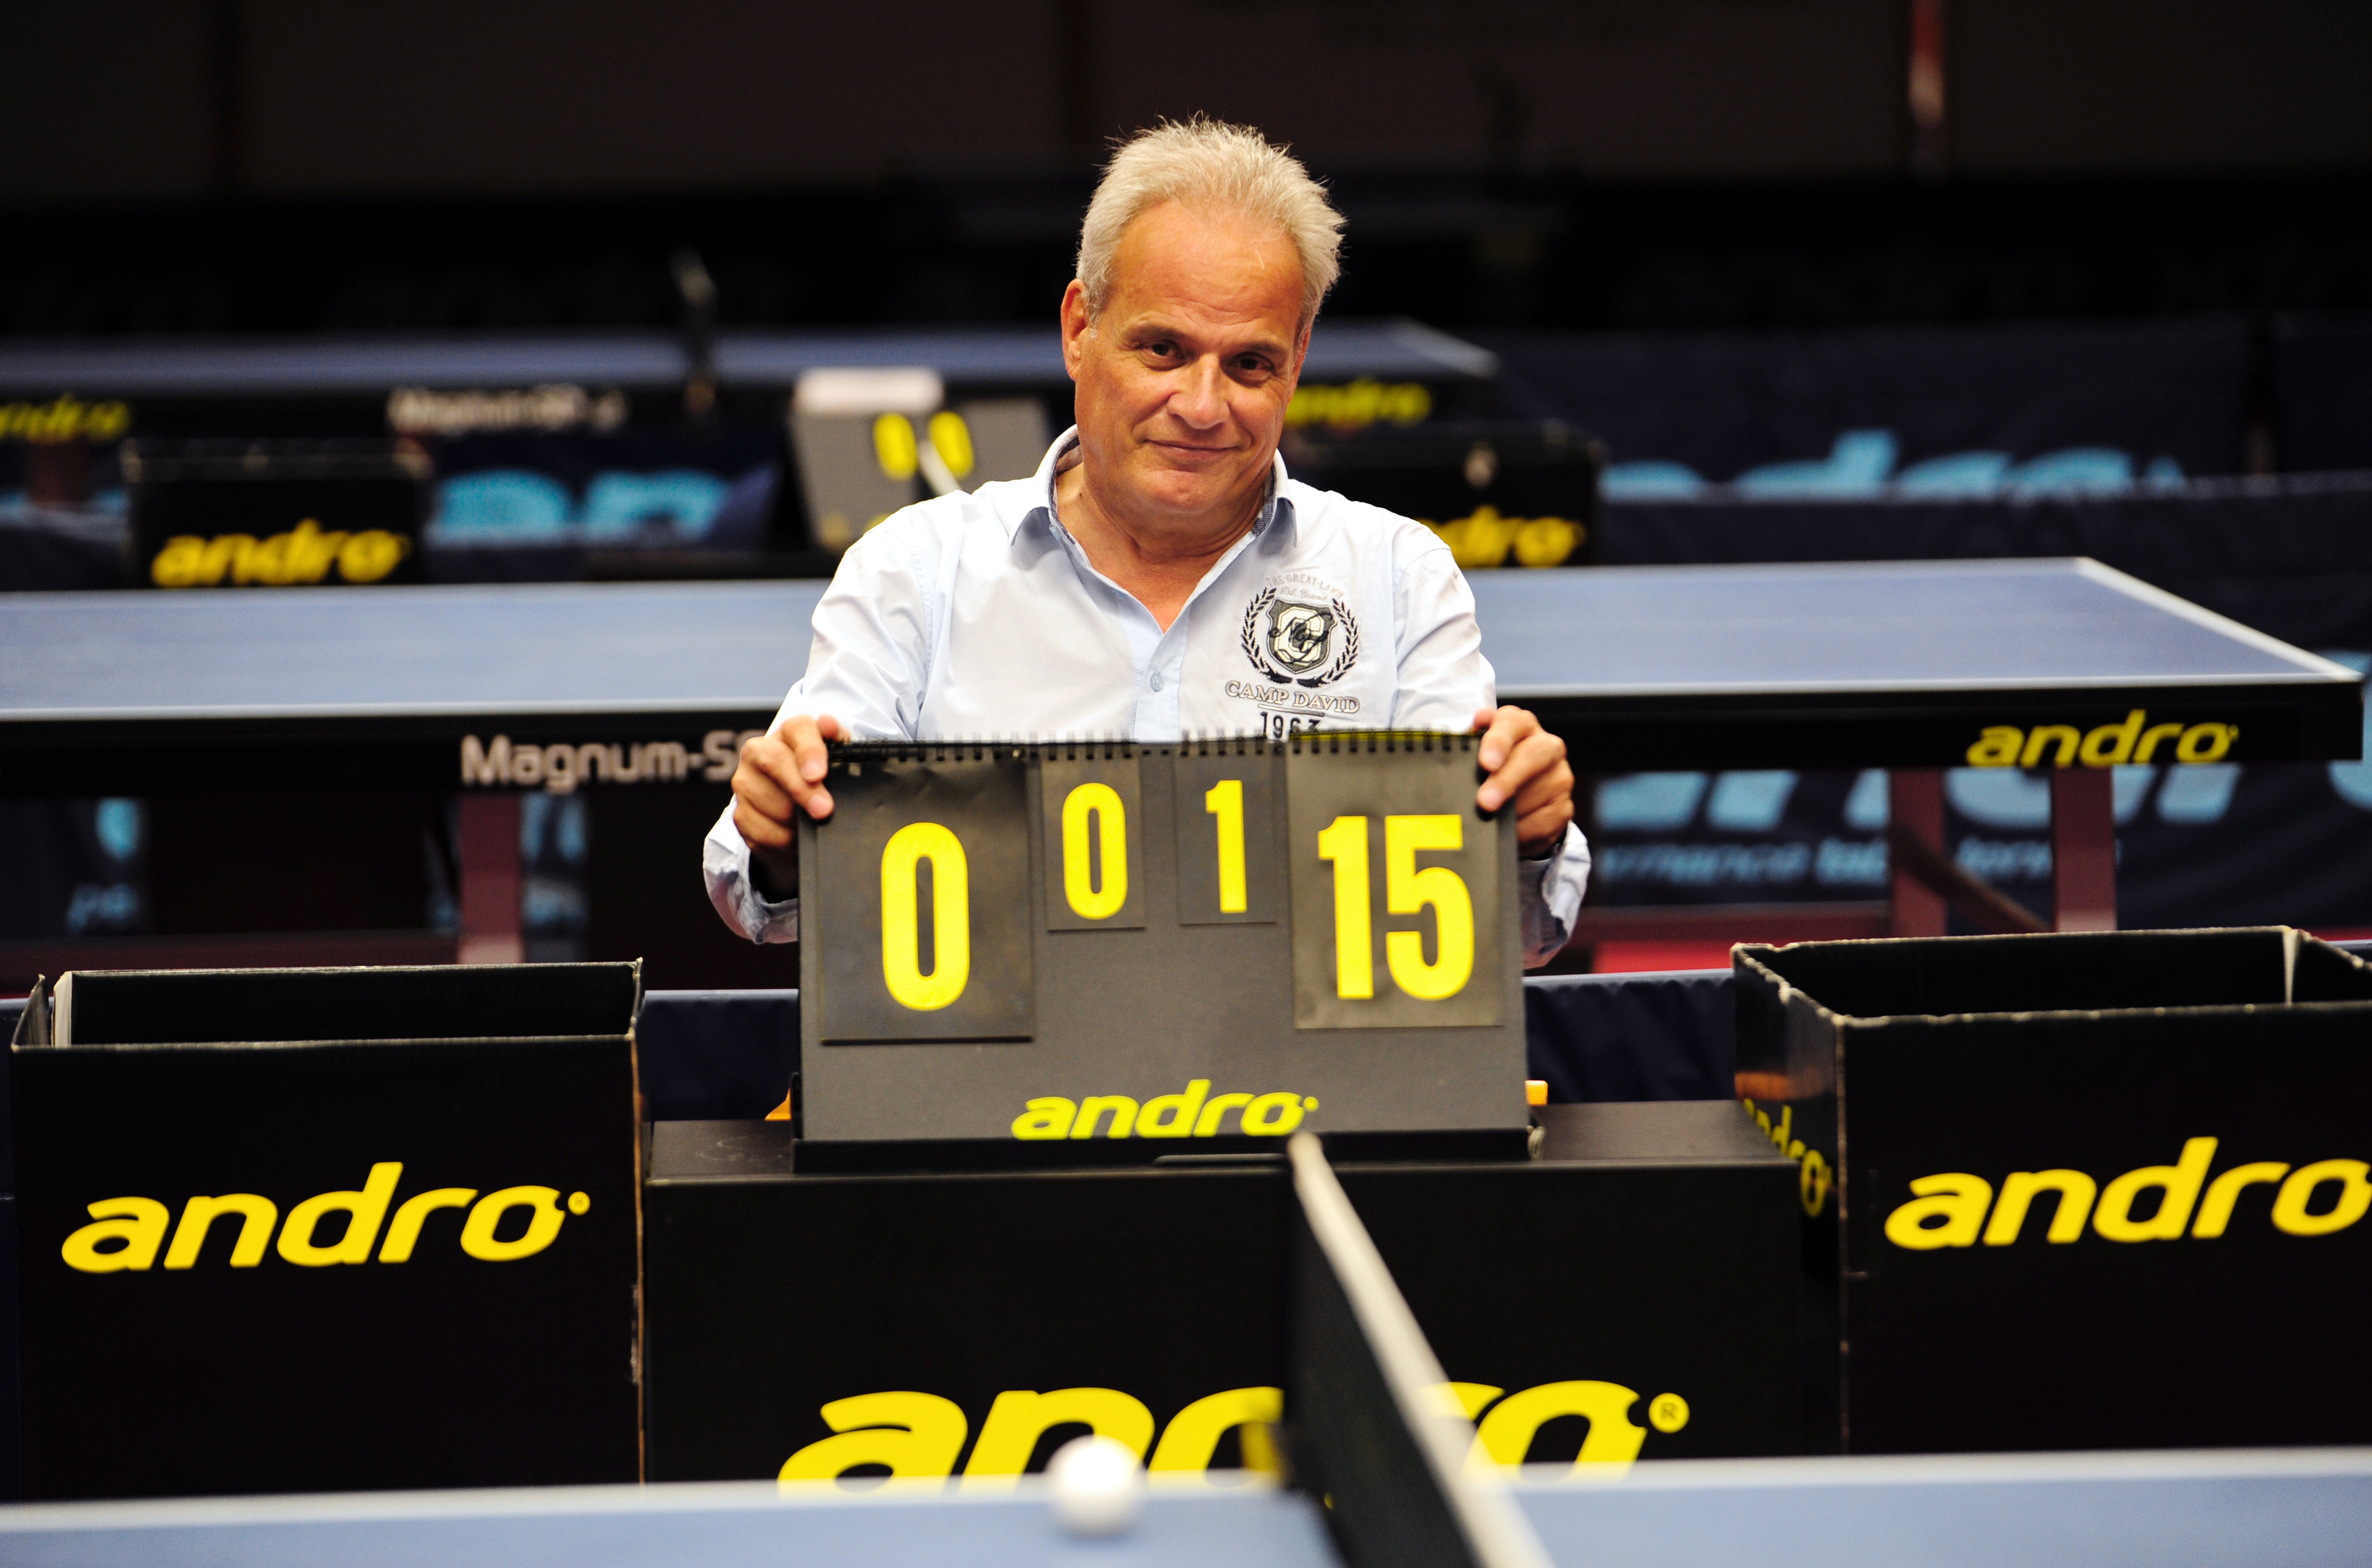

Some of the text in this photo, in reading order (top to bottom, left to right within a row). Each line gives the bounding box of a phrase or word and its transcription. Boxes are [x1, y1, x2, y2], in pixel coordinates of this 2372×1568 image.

[1265, 575, 1285, 587] THE
[1225, 680, 1360, 713] CAMP DAVID
[1967, 710, 2231, 768] andro
[881, 779, 1475, 1011] 0 0 1 15
[1011, 1079, 1305, 1140] andro
[61, 1161, 565, 1273] andro
[1885, 1137, 2372, 1250] andro
